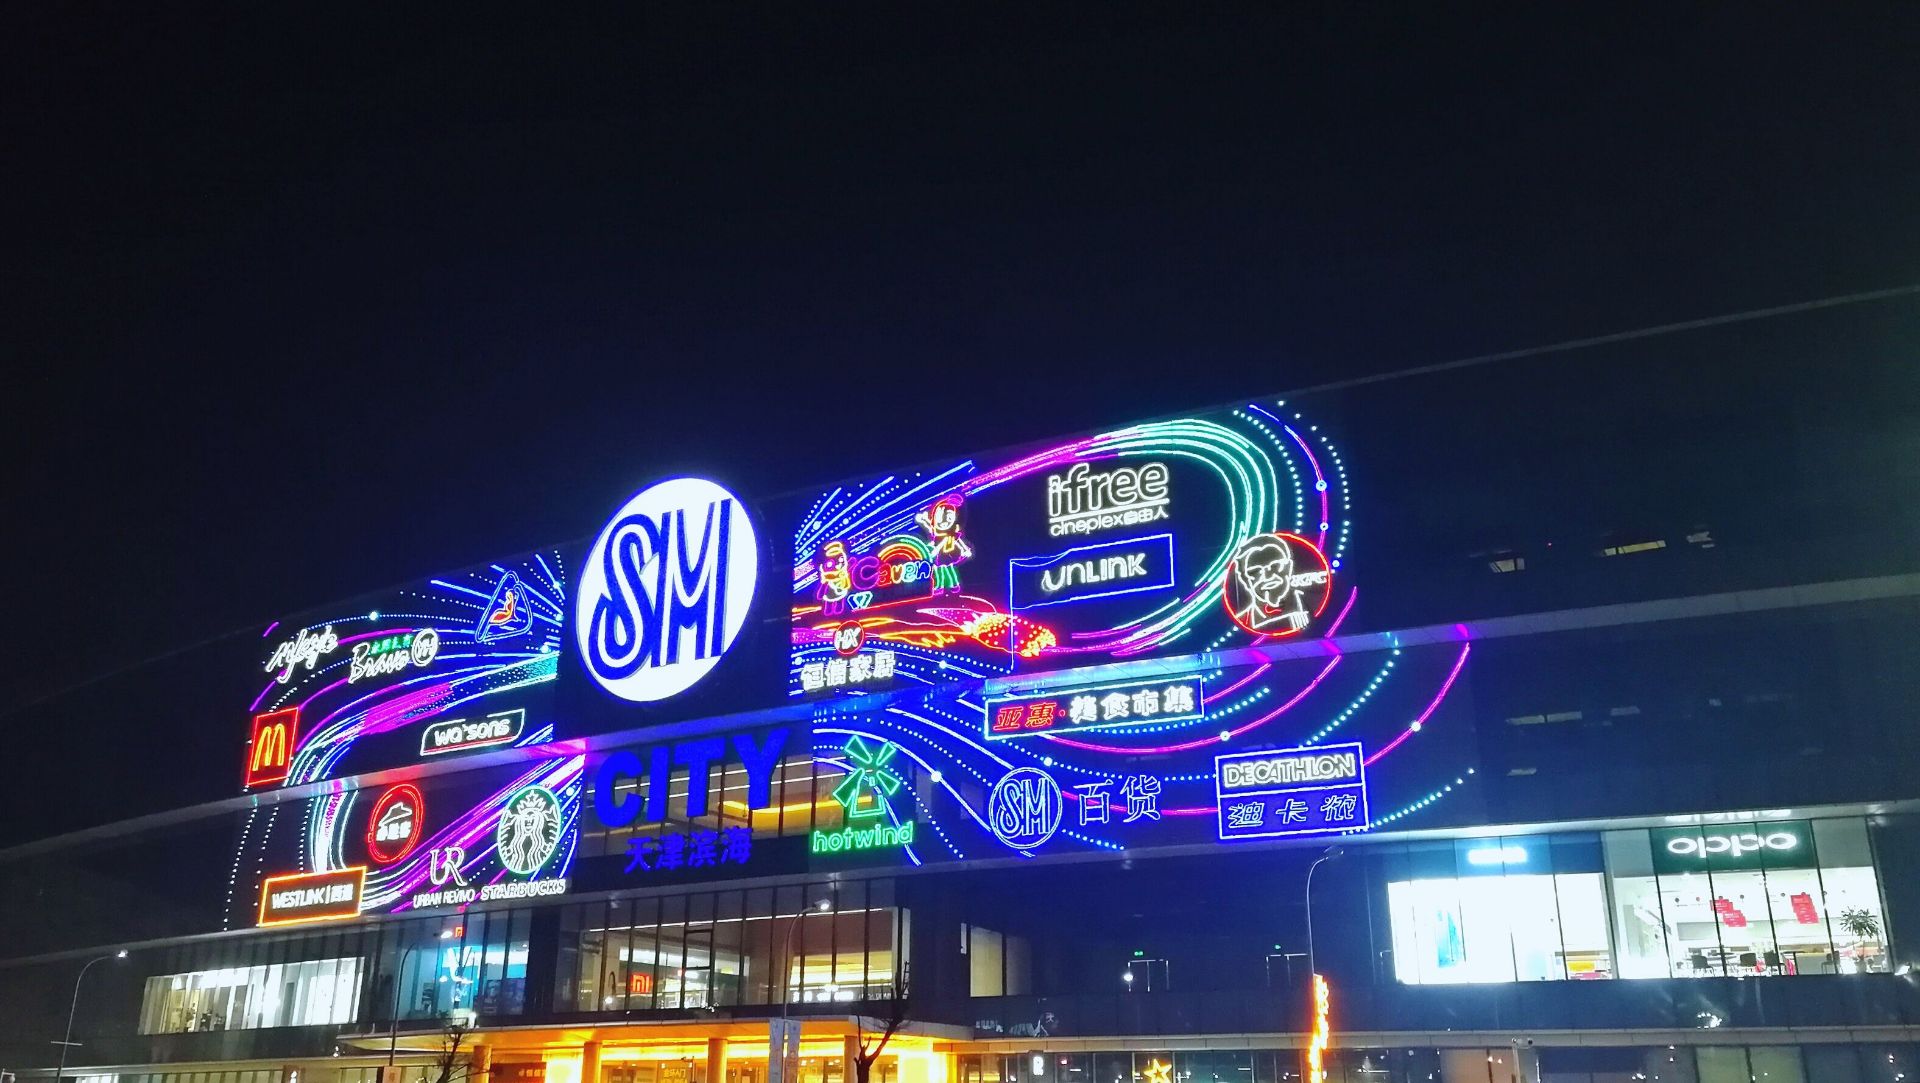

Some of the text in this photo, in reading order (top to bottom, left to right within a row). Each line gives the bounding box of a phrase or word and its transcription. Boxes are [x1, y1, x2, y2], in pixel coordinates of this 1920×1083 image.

[1048, 462, 1169, 518] ifree
[588, 498, 733, 681] SM
[594, 728, 790, 828] CITY
[1222, 752, 1357, 788] DECATHLON
[998, 775, 1162, 838] SM 百货
[624, 828, 753, 874] 天津滨海
[812, 820, 913, 853] hotwind
[413, 890, 443, 909] URBAN
[480, 878, 567, 901] STARBUCKS
